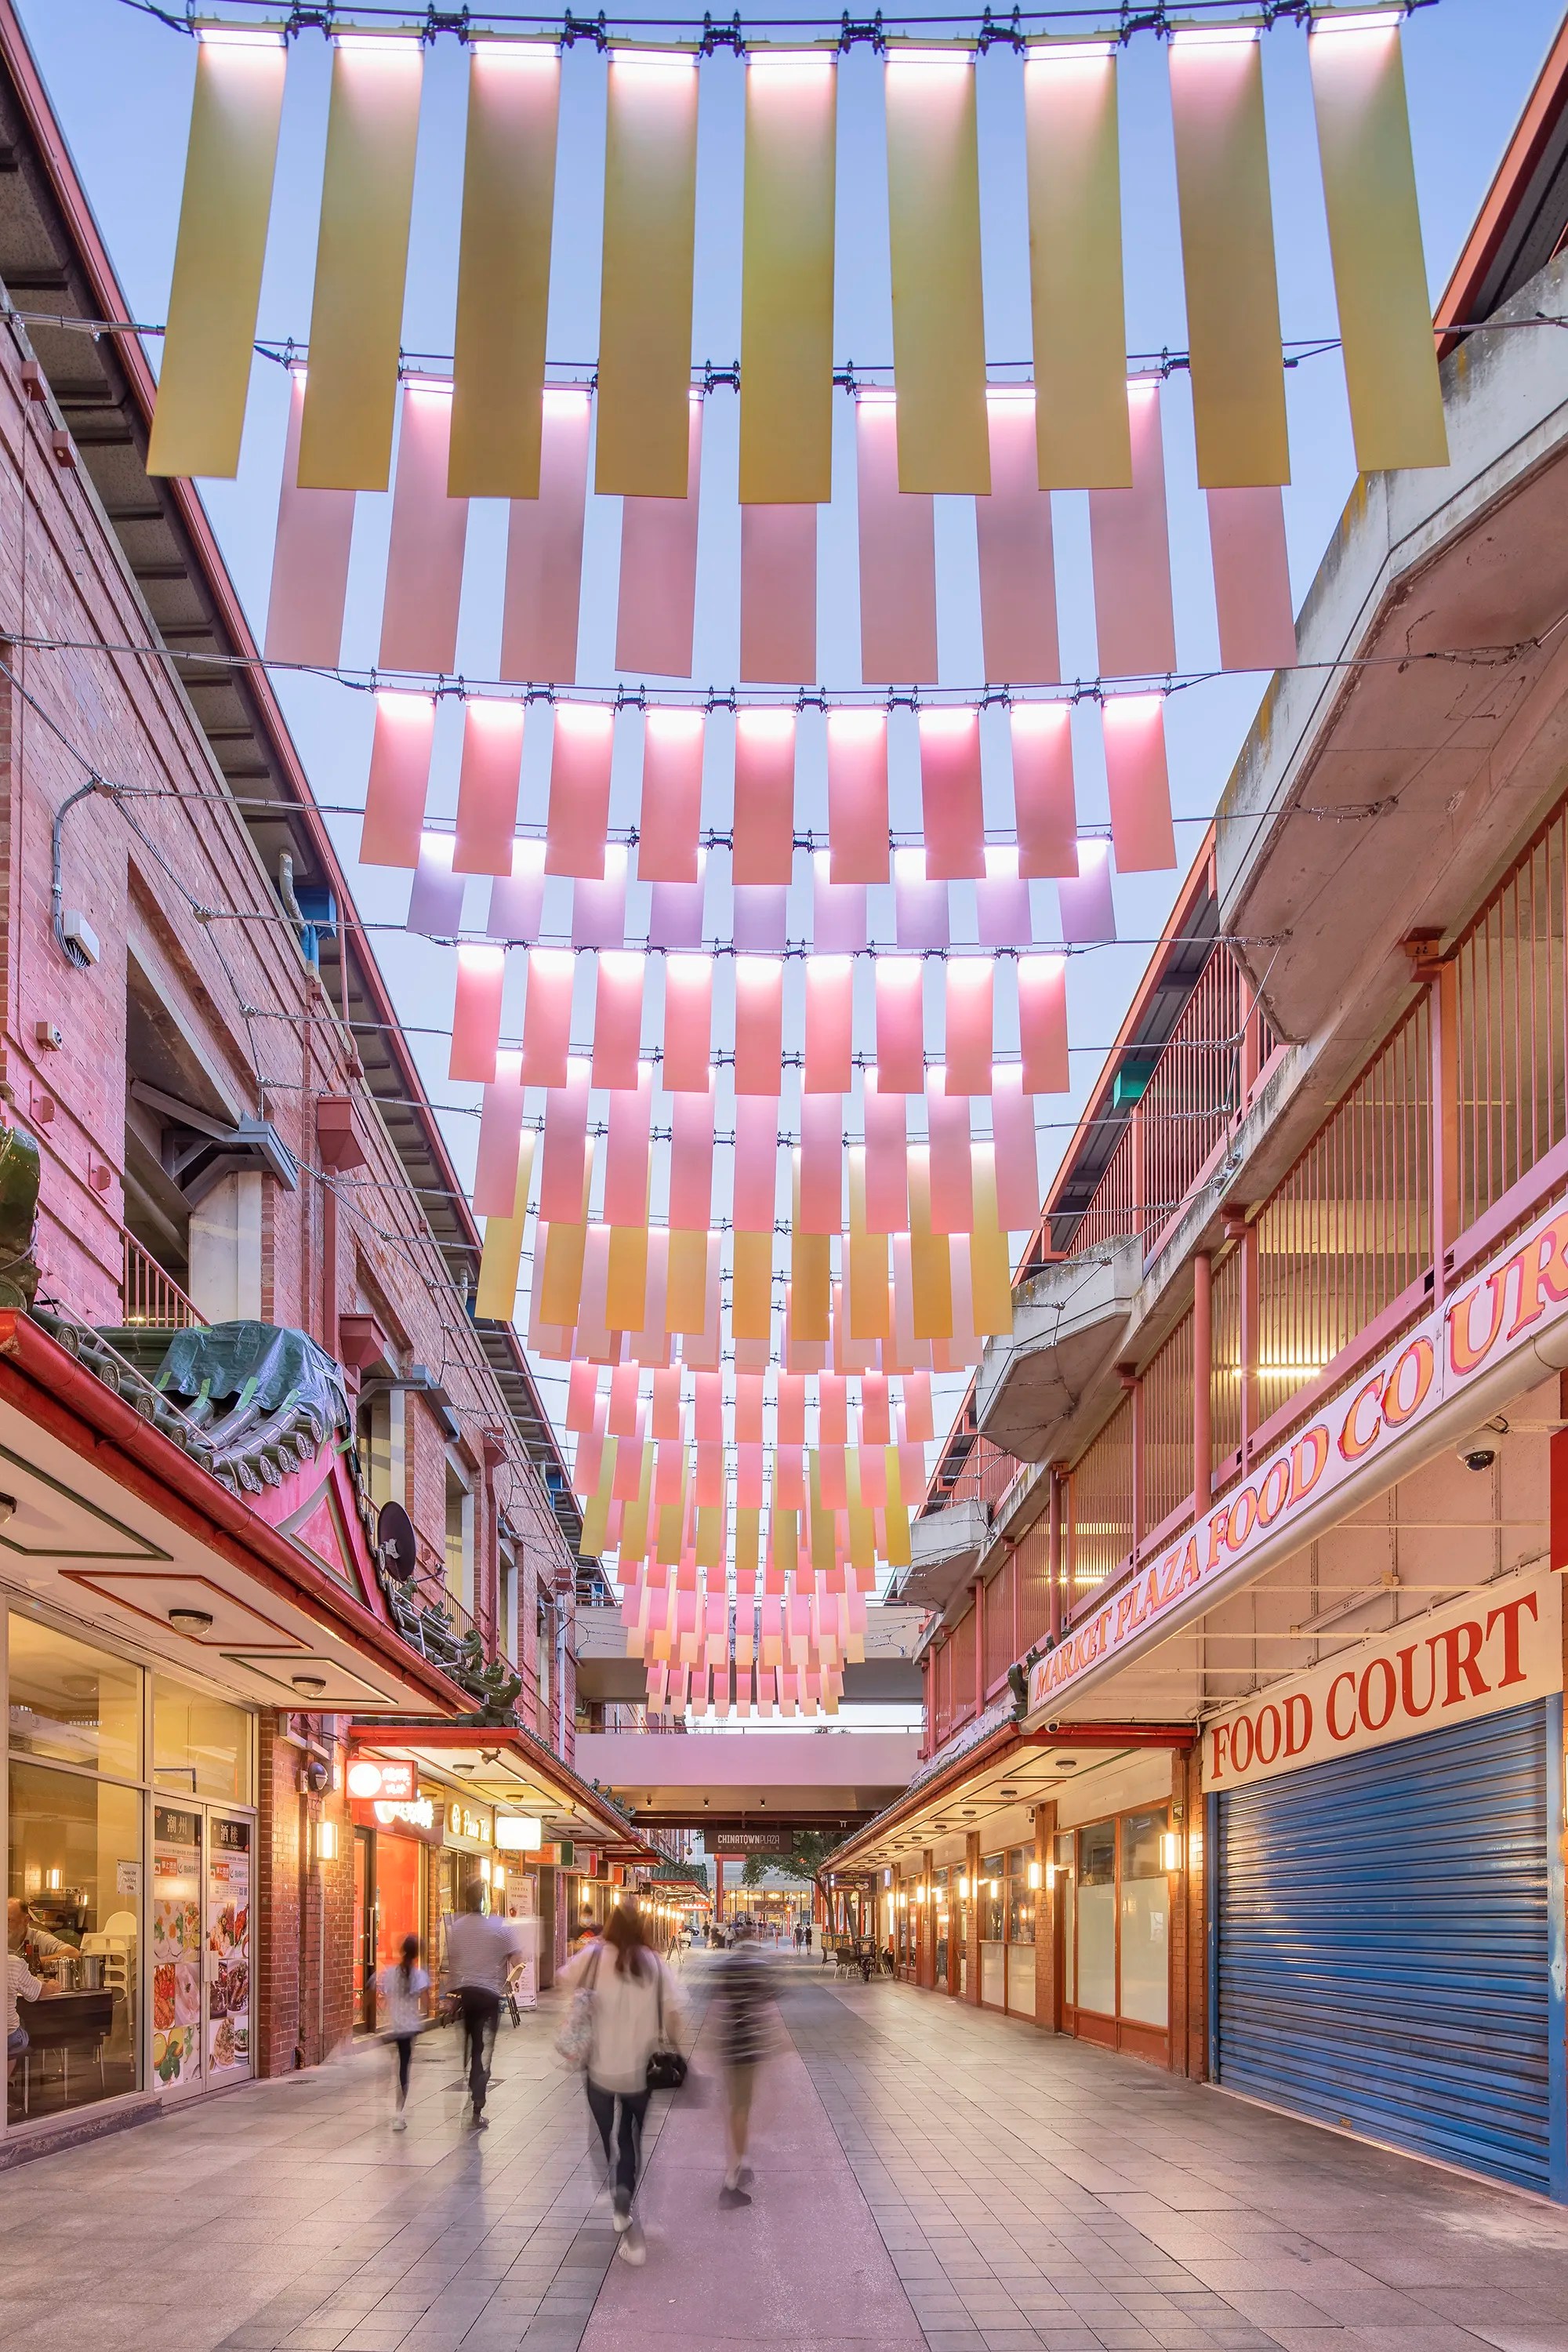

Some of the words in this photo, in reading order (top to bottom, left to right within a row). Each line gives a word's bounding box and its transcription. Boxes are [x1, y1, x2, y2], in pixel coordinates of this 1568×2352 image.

[1035, 1605, 1113, 1702] MARKET
[1113, 1534, 1201, 1645] PLAZA
[1206, 1424, 1330, 1573] FOOD
[1210, 1693, 1312, 1780] FOOD
[1326, 1591, 1538, 1741] COURT
[167, 1814, 187, 1835] 潮州
[220, 1824, 238, 1843] 酒楼
